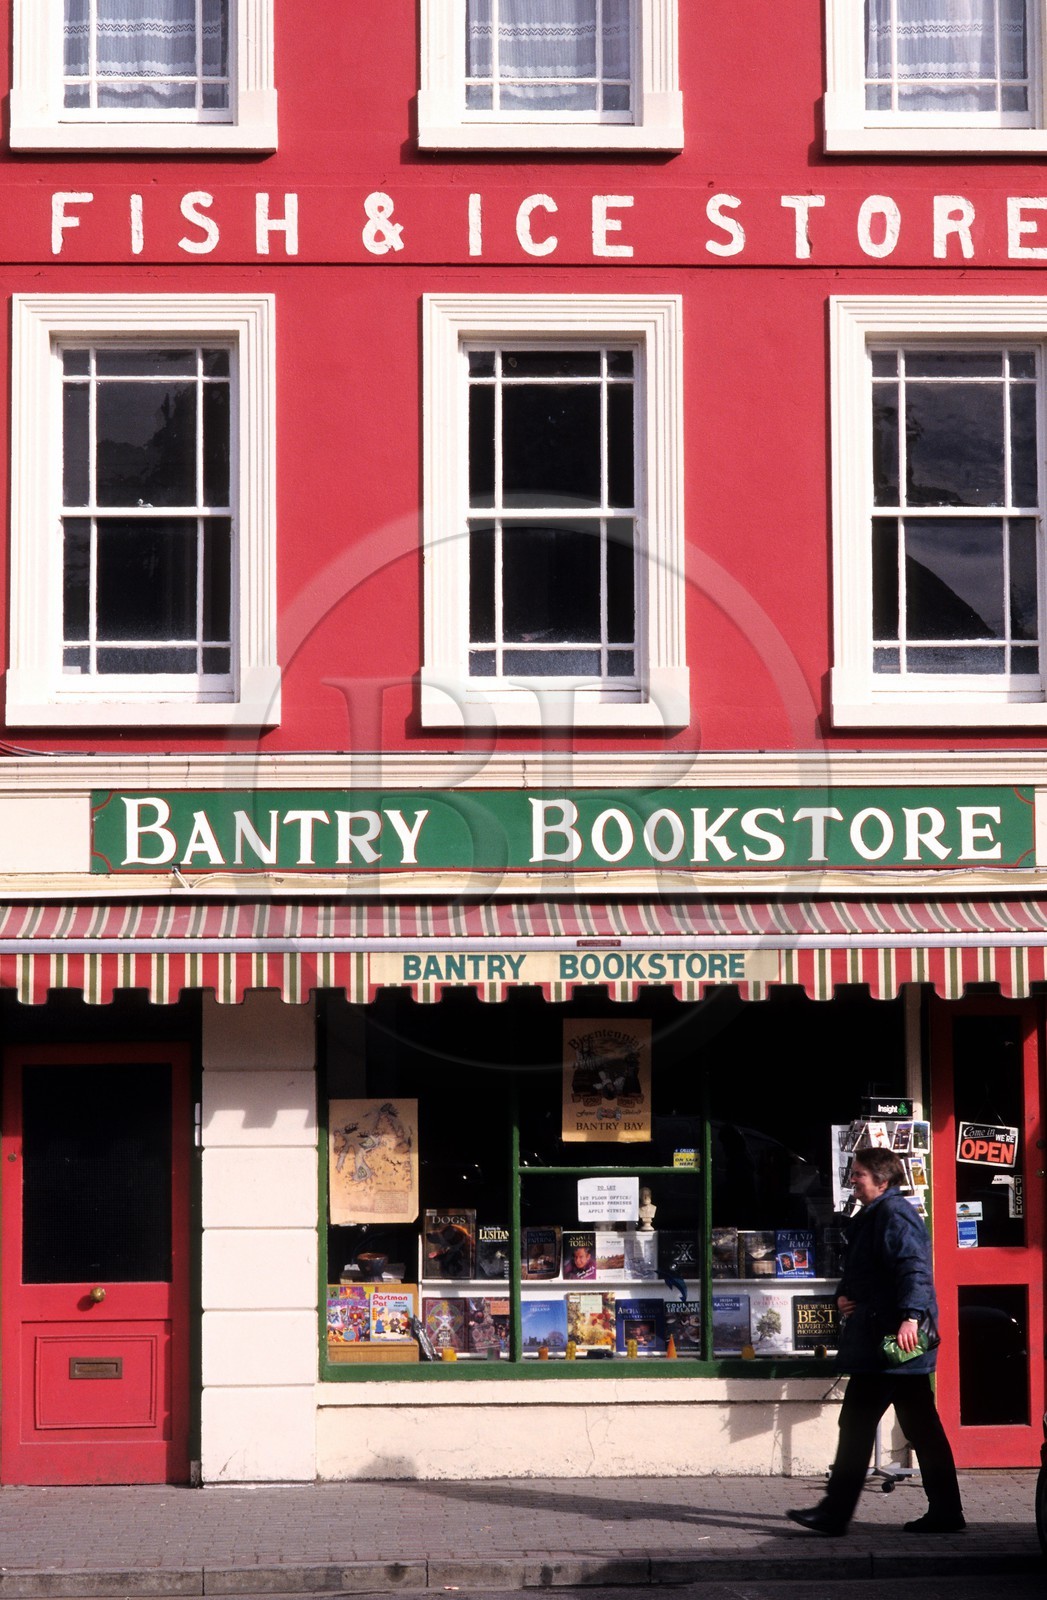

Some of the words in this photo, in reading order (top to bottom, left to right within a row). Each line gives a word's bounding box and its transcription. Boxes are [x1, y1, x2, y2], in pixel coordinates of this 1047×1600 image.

[51, 190, 299, 255] FISH
[361, 191, 405, 255] &
[468, 193, 635, 257] ICE
[705, 194, 1047, 259] STORE
[120, 796, 429, 867] BANTRY
[528, 797, 1002, 863] BOOKSTORE
[403, 954, 525, 980] BANTRY
[559, 952, 744, 979] BOOKSTORE
[878, 1104, 898, 1114] Insight
[576, 1122, 620, 1131] BANTRY
[624, 1122, 644, 1131] BAY
[962, 1126, 986, 1138] Come
[986, 1127, 996, 1137] in
[995, 1133, 1015, 1143] WE'RE
[961, 1139, 1015, 1164] OPEN
[1015, 1178, 1023, 1214] PUSH
[432, 1216, 466, 1224] DOGS
[777, 1233, 813, 1241] ISLAND
[796, 1309, 837, 1324] BEST
